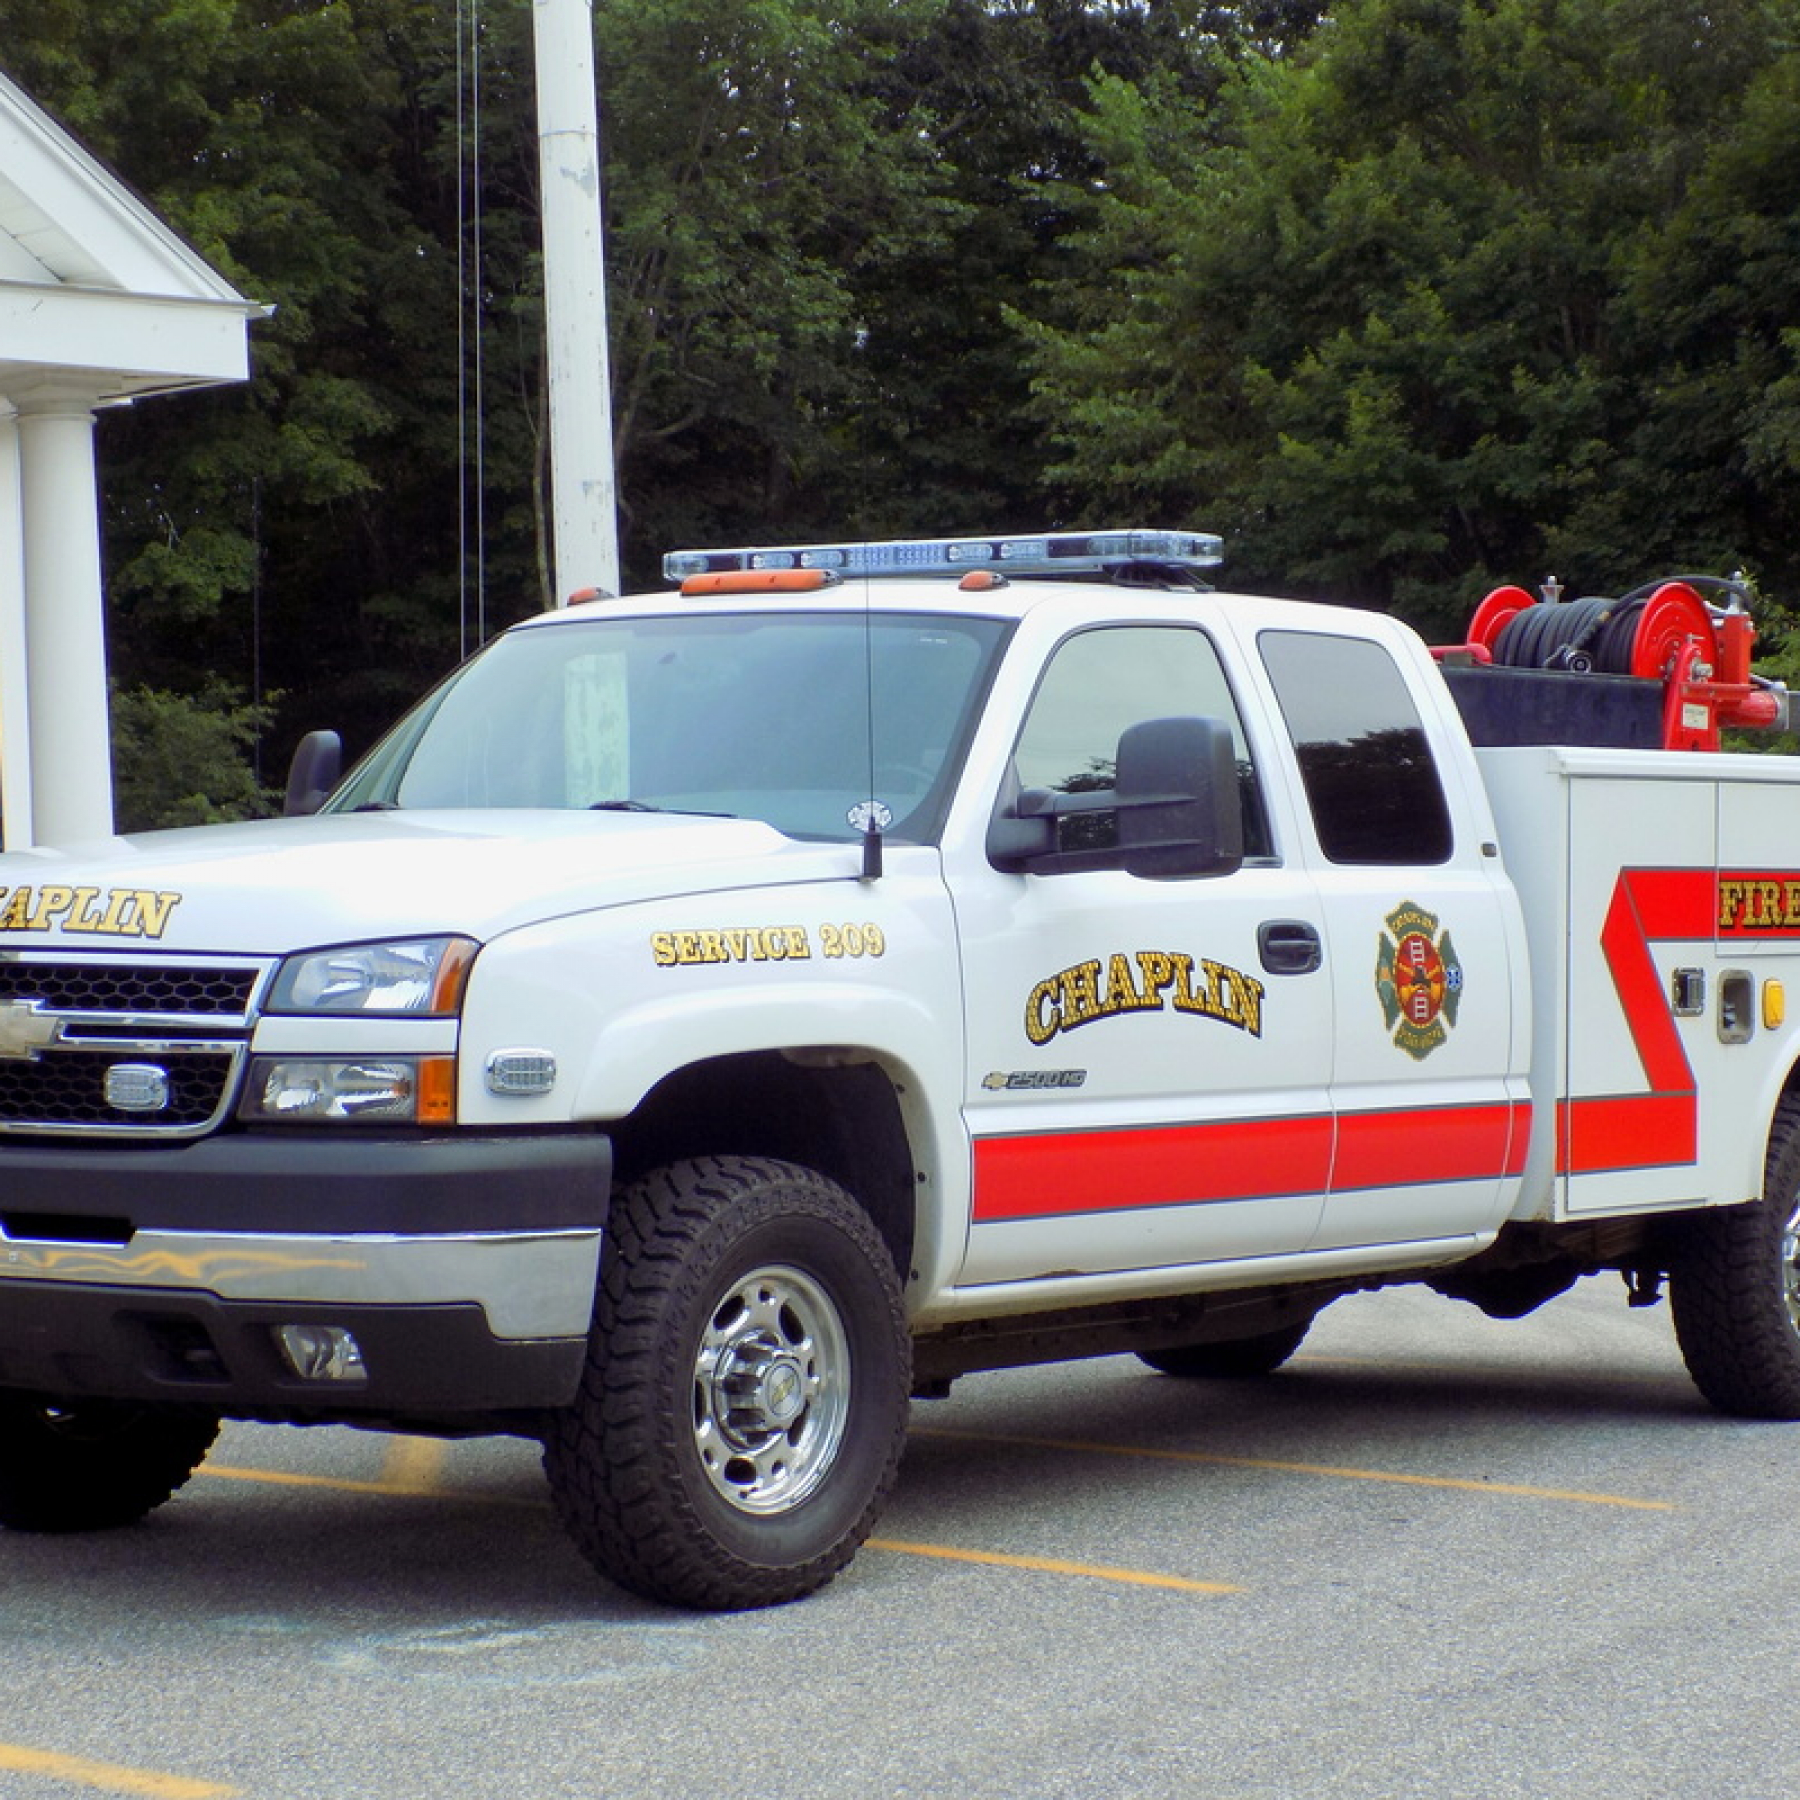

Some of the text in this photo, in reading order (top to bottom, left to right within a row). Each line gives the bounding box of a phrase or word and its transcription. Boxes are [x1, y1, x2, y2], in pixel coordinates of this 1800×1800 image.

[0, 884, 182, 939] APLIN
[1718, 880, 1800, 929] FIRE
[651, 922, 886, 967] SERVICE 209
[1025, 951, 1265, 1046] CHAPLIN
